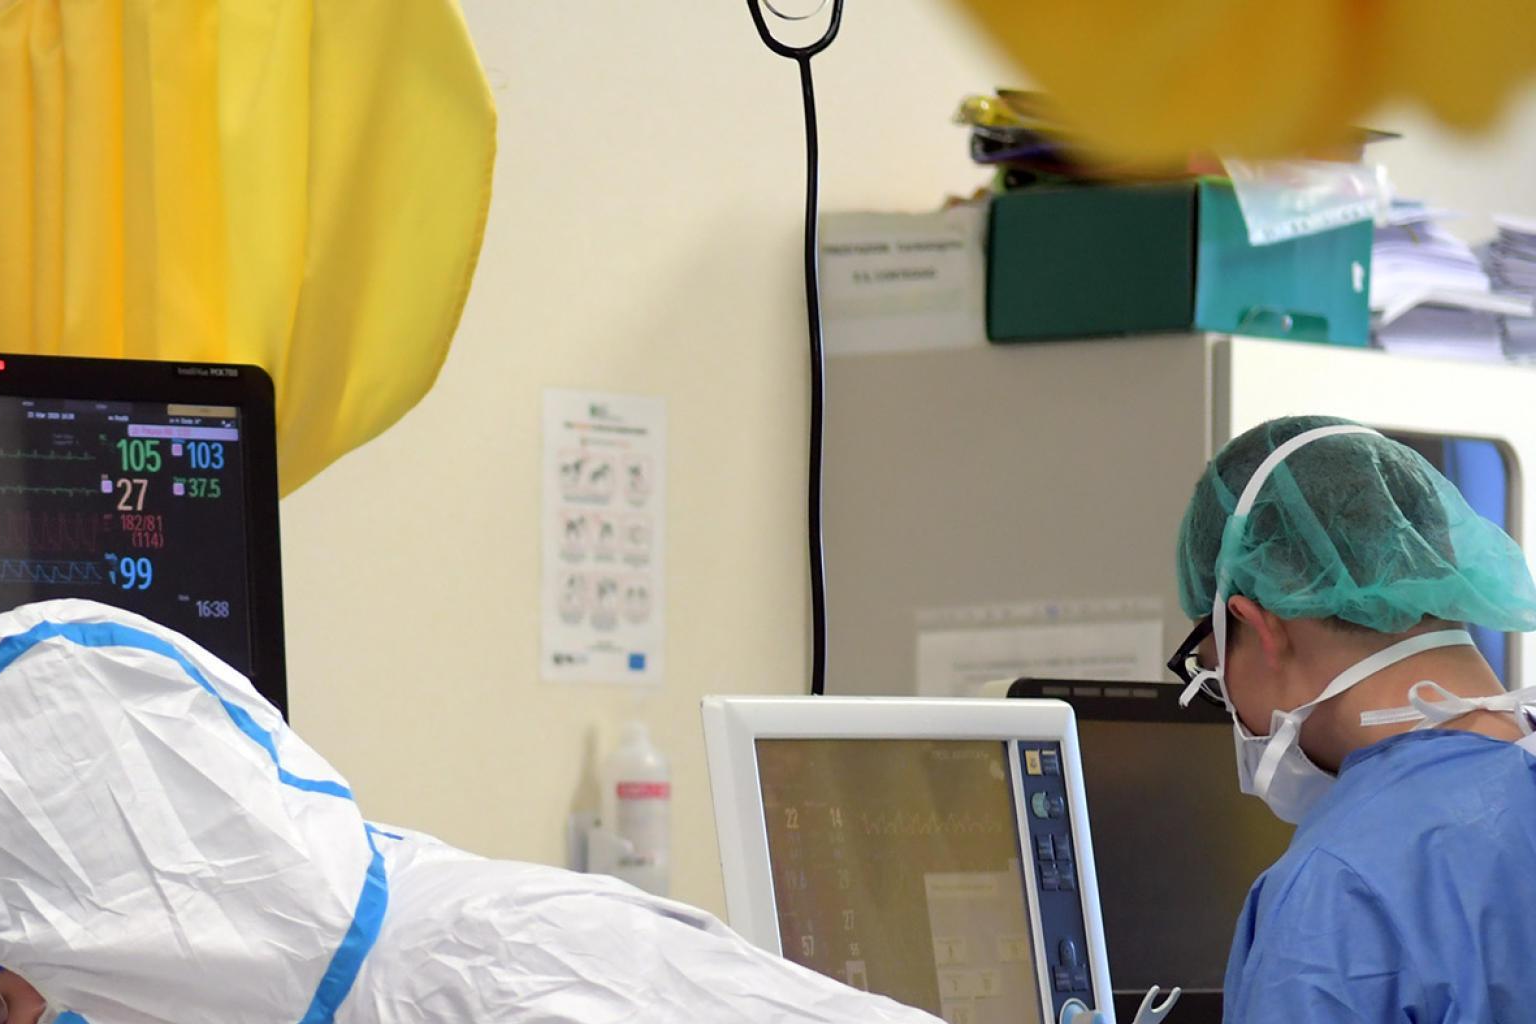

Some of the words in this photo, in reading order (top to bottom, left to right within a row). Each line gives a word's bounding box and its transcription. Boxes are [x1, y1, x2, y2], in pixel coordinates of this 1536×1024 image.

[116, 439, 162, 473] 105
[186, 441, 225, 469] 103
[116, 478, 149, 511] 27
[188, 477, 221, 498] 37.5
[120, 513, 163, 531] 182/81
[131, 532, 164, 548] (114)
[119, 556, 153, 590] 99
